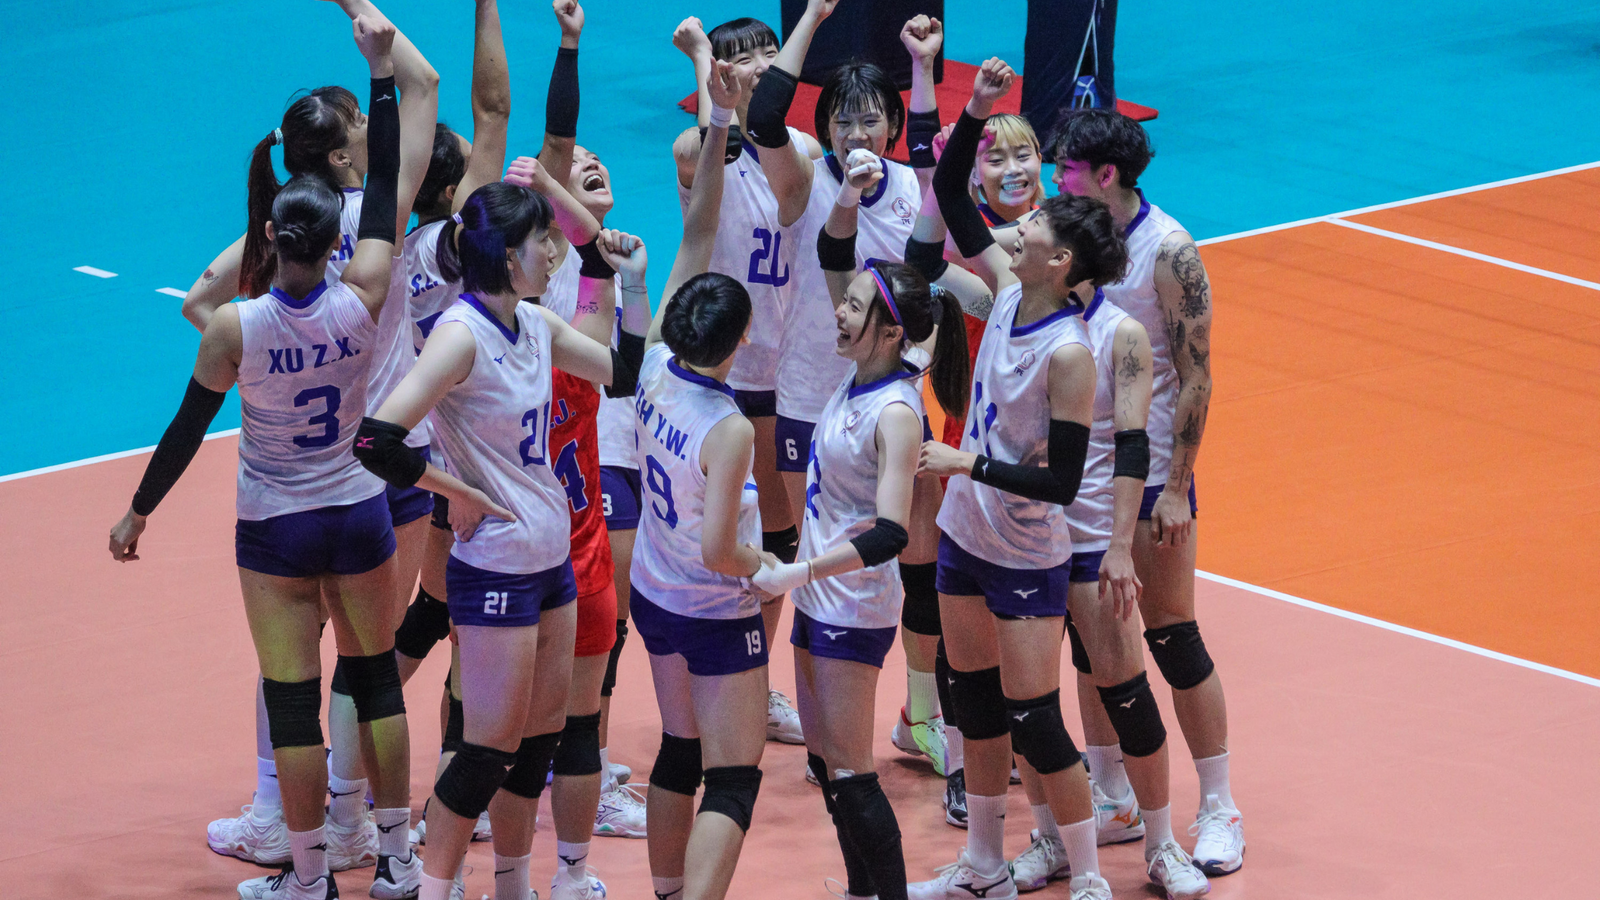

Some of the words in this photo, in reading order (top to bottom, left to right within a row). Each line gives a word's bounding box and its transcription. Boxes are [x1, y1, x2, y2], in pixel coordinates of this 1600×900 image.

[267, 348, 305, 375] XU
[311, 336, 361, 369] Z.X.
[292, 384, 342, 449] 3
[518, 400, 550, 468] 21
[653, 412, 689, 461] Y.W.
[784, 438, 798, 460] 6
[483, 591, 508, 615] 21
[745, 630, 762, 655] 19
